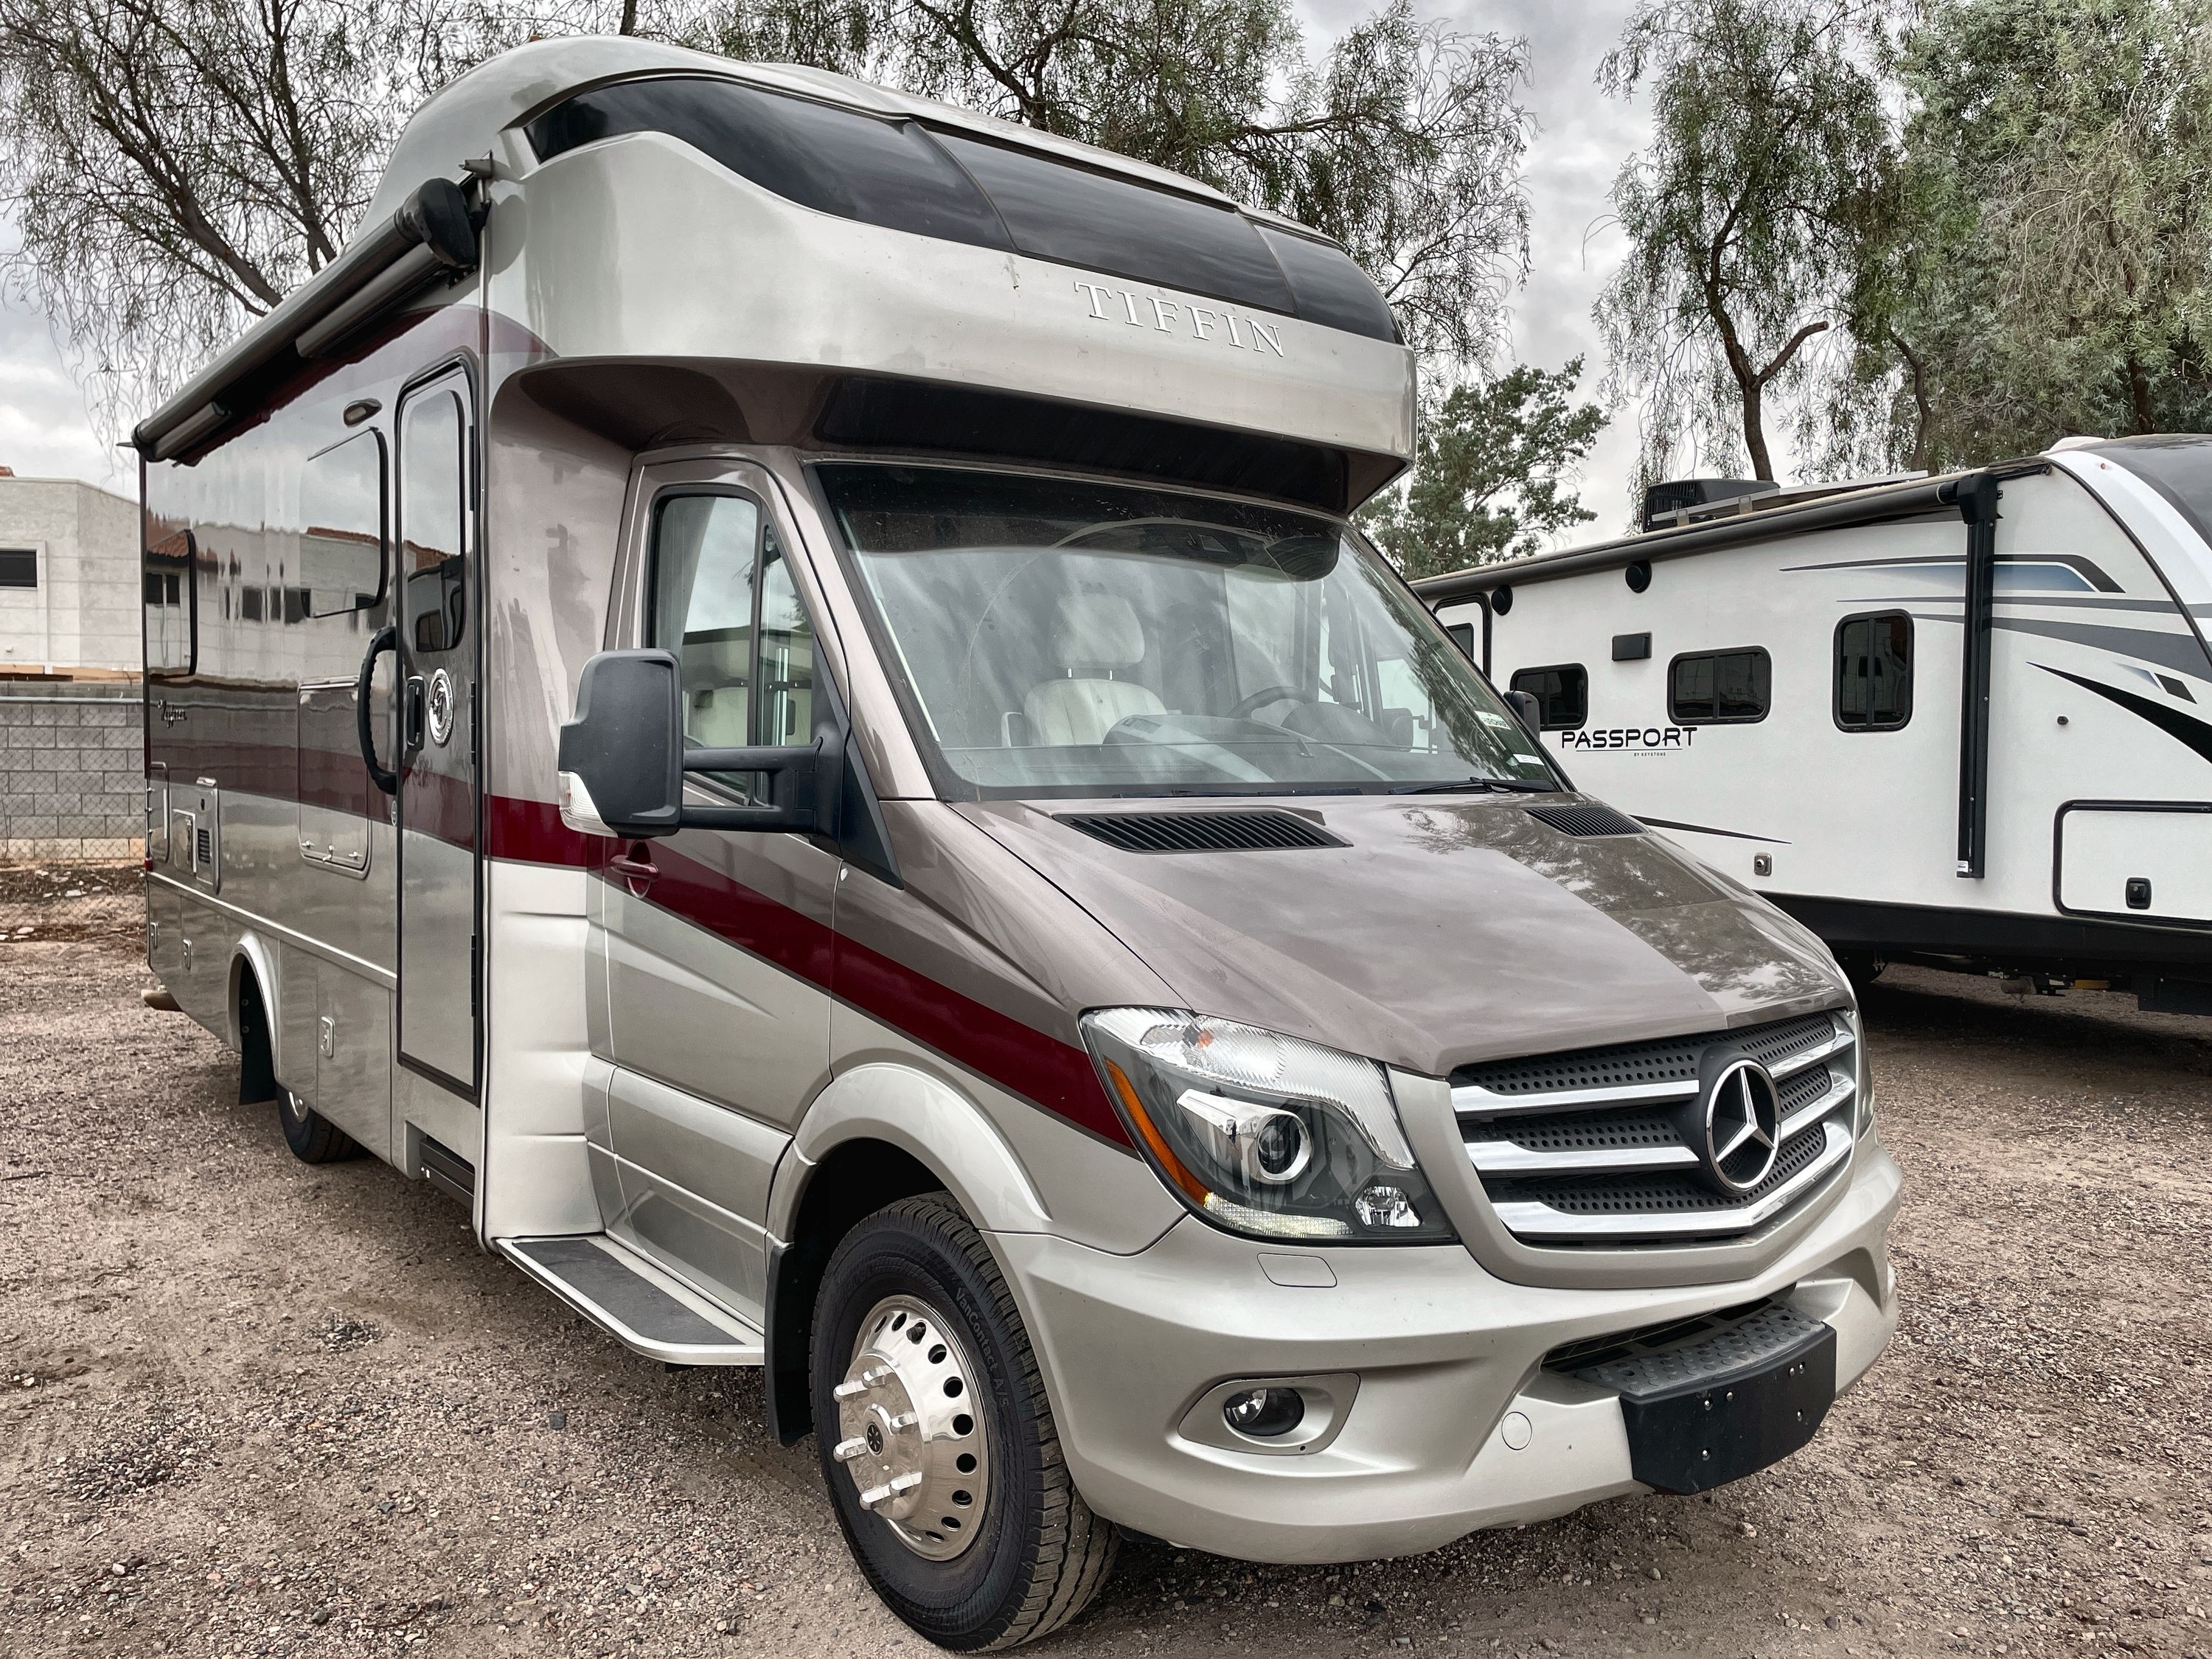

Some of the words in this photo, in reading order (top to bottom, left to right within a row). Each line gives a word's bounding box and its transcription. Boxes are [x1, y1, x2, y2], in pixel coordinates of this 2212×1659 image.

[1074, 281, 1284, 358] TIFFIN
[1562, 727, 1697, 748] PASSPORT
[956, 1287, 998, 1372] VanContact
[994, 1378, 1009, 1407] A/S
